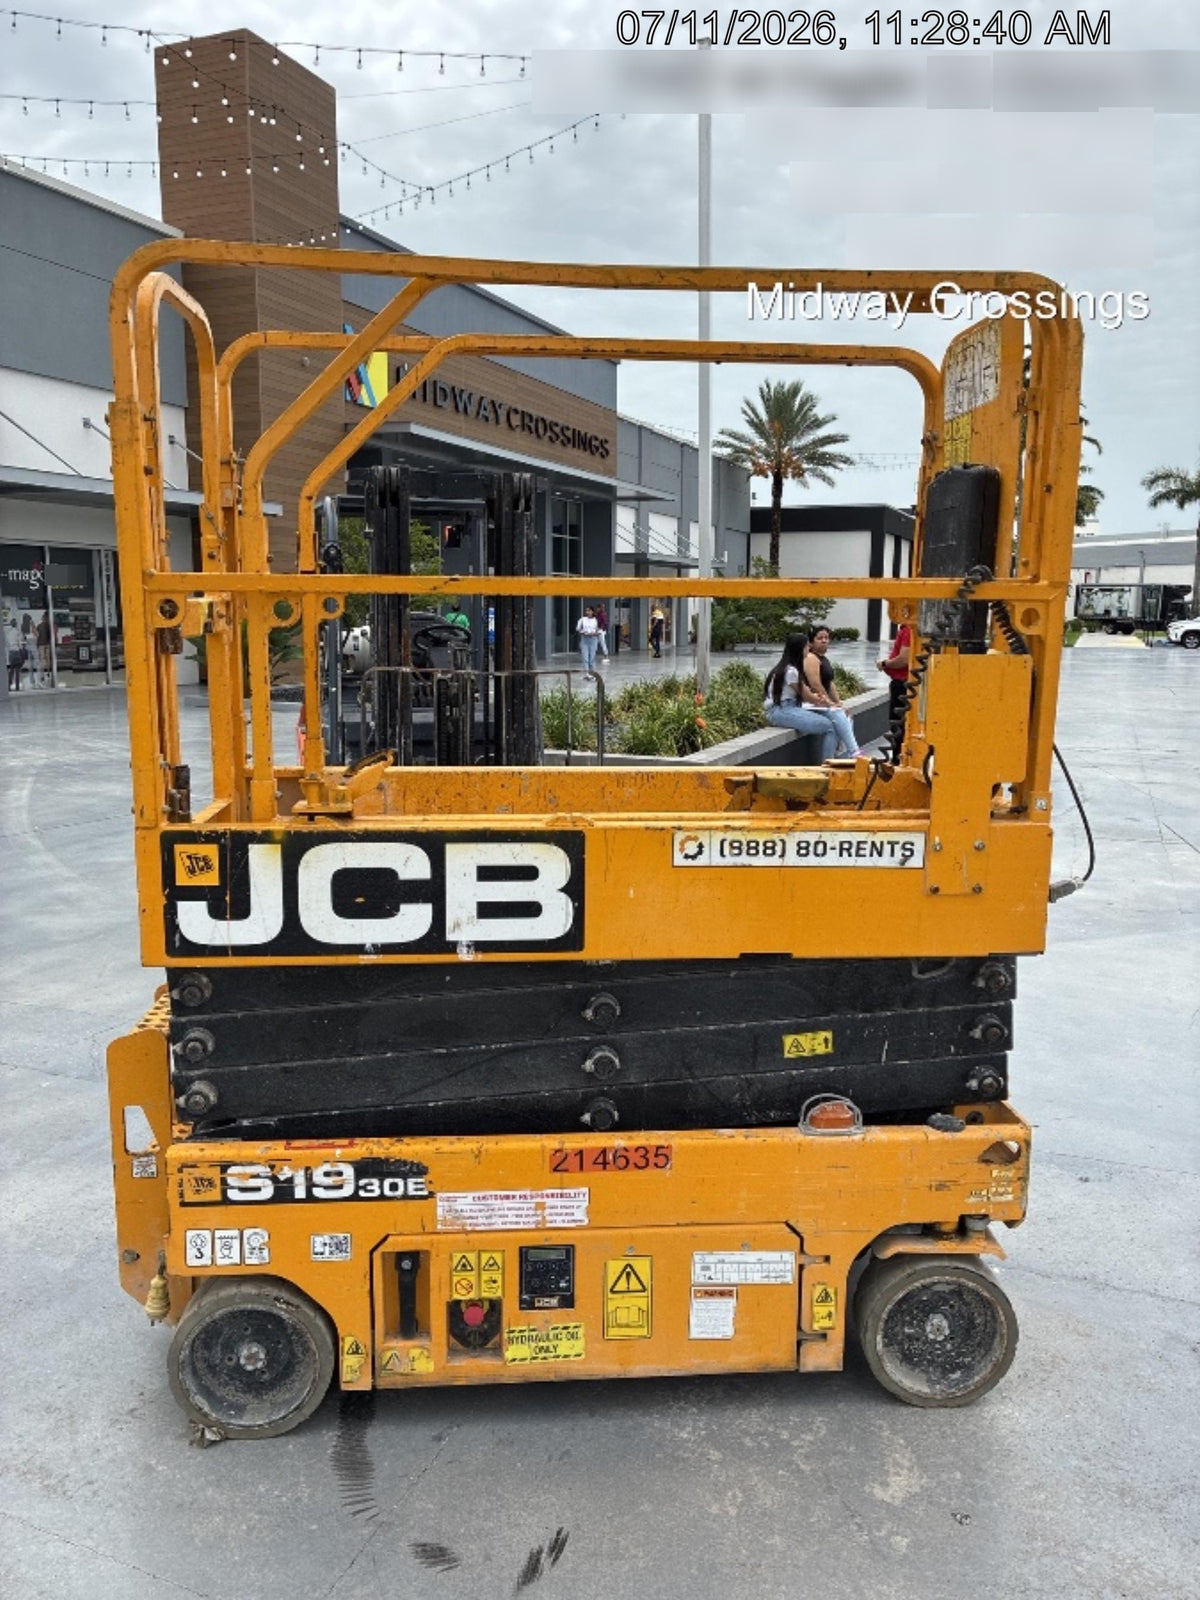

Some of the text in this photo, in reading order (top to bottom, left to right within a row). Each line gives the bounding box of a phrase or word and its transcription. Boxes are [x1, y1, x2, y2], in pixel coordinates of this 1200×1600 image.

[719, 838, 915, 859] (888) 80-RENTS
[184, 853, 214, 875] JCB
[176, 842, 574, 945] JCB
[552, 1145, 671, 1172] 214635
[533, 1344, 559, 1355] ONLY
